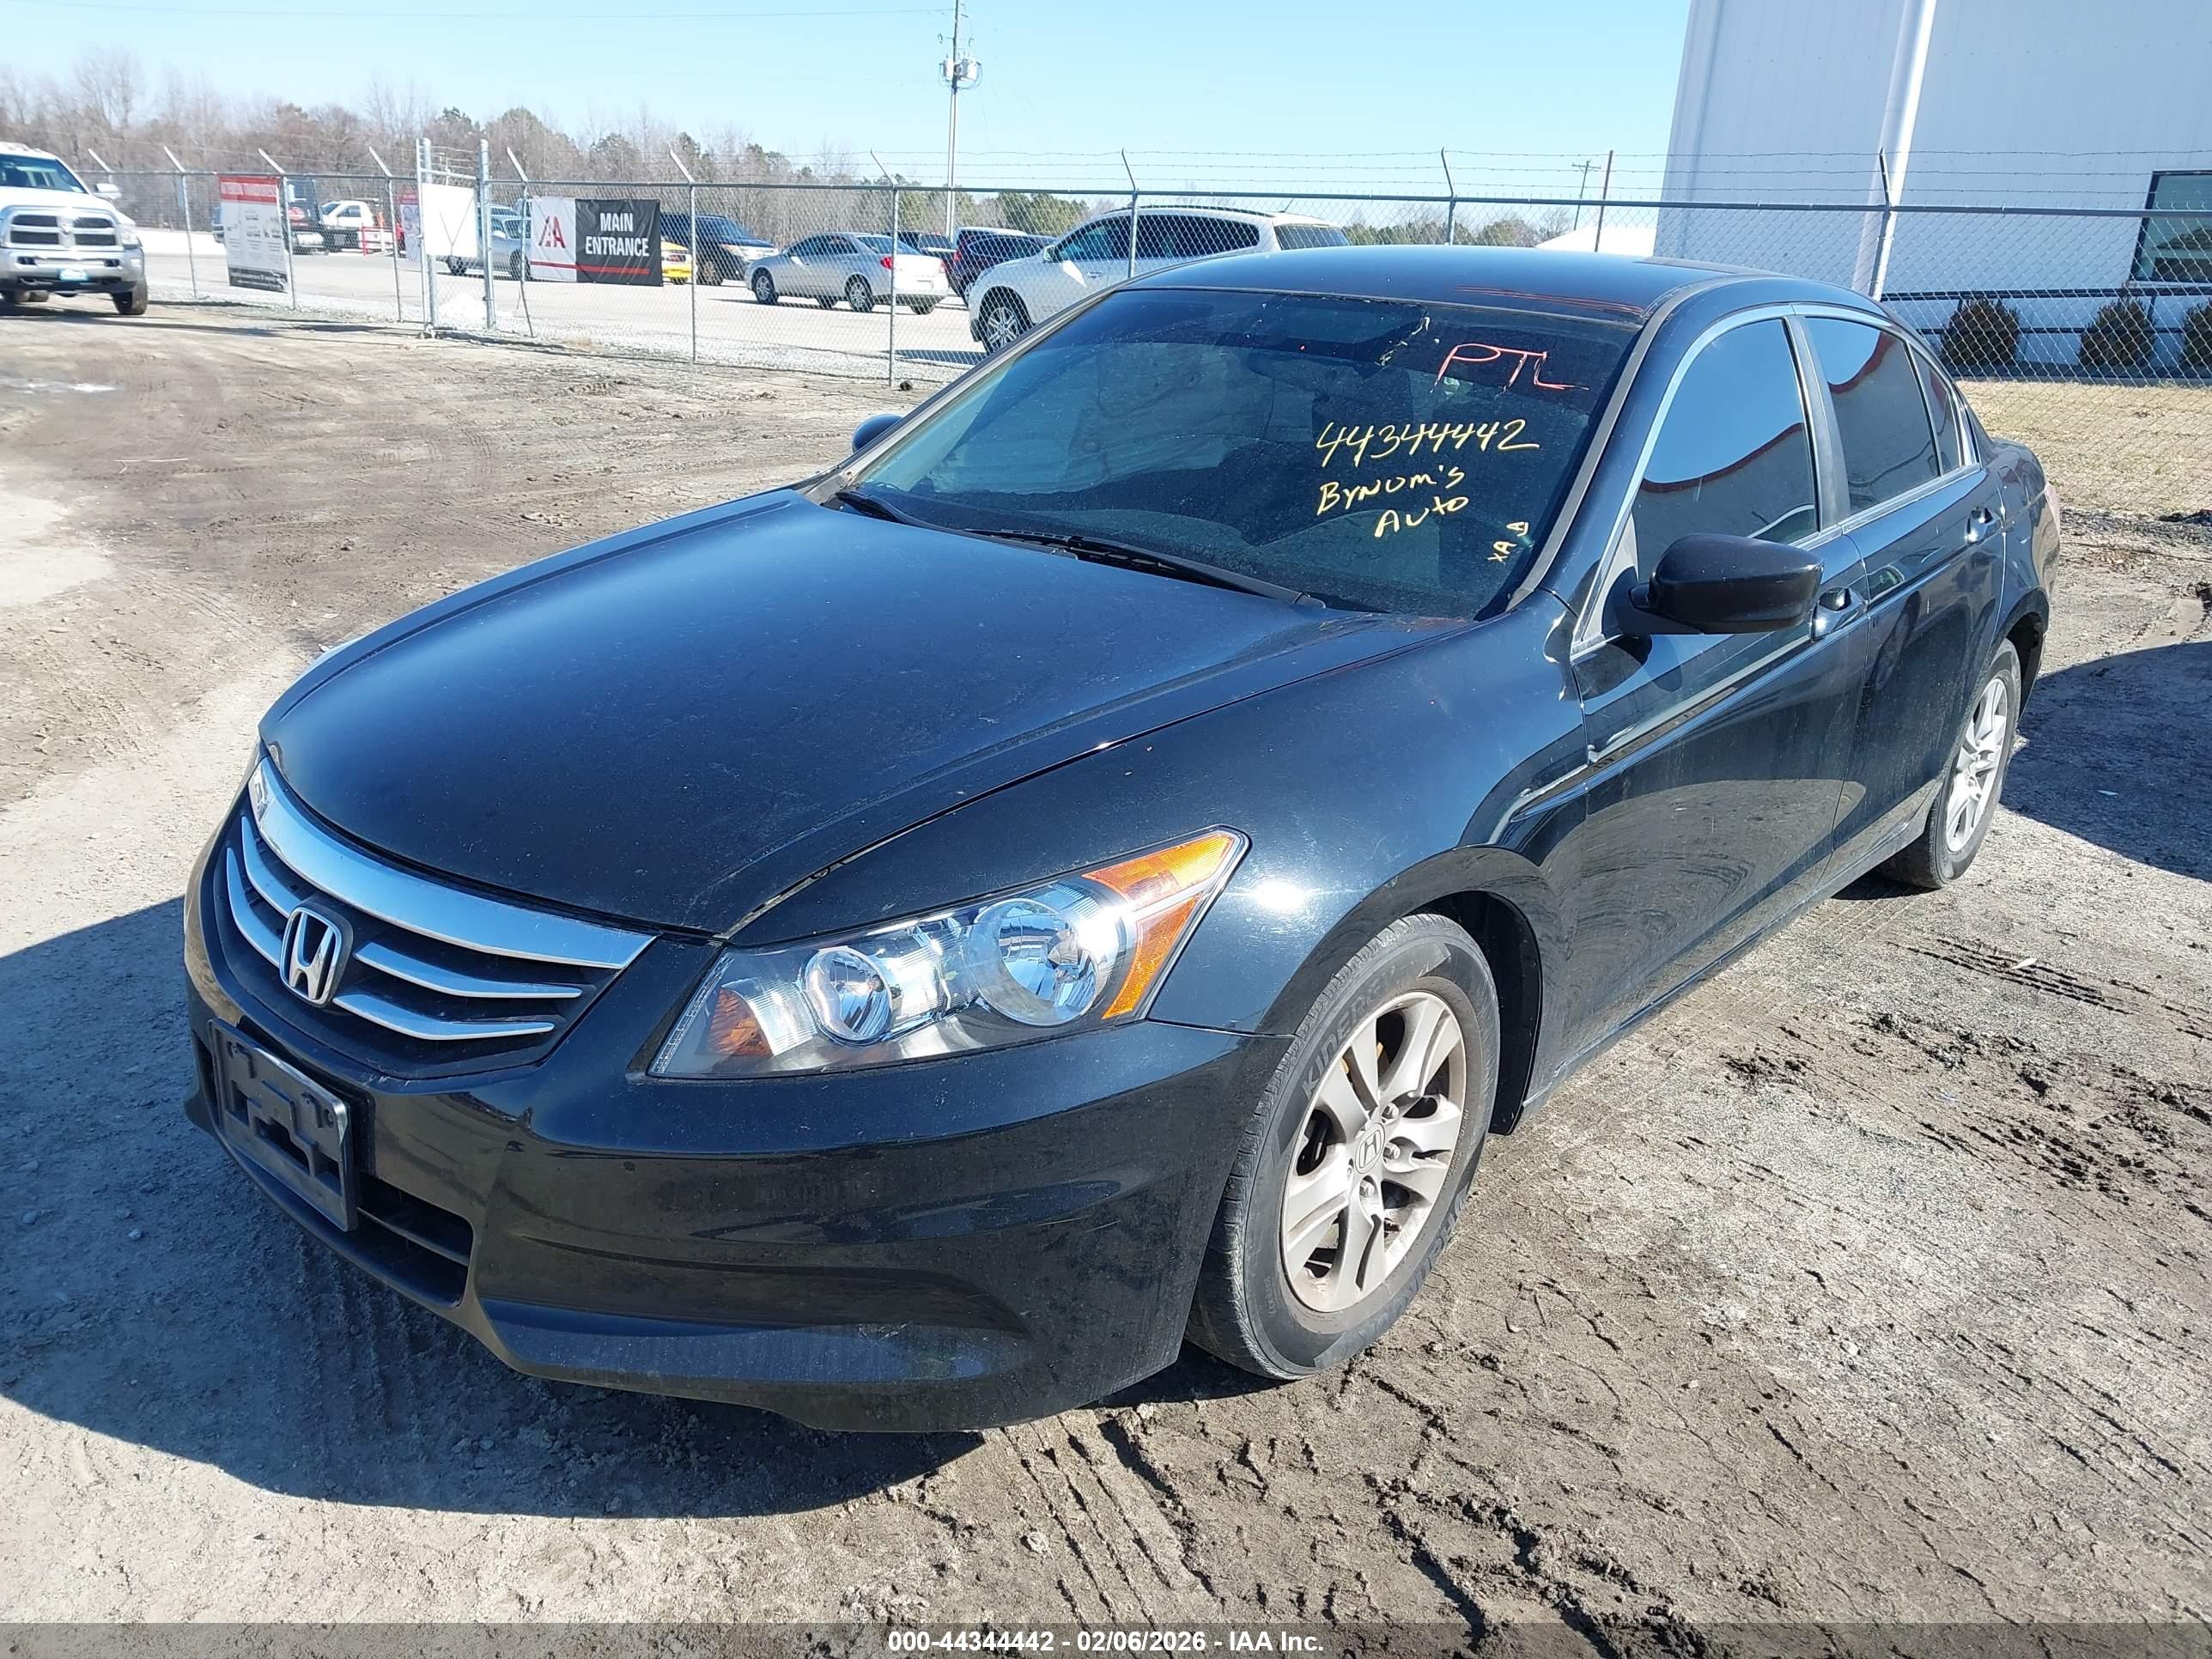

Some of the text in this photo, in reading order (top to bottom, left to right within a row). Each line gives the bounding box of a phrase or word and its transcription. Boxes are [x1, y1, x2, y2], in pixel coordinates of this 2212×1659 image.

[599, 212, 634, 233] MAIN
[585, 235, 650, 258] ENTRANCE
[1429, 343, 1590, 398] PTL
[1316, 418, 1540, 468] 44344442
